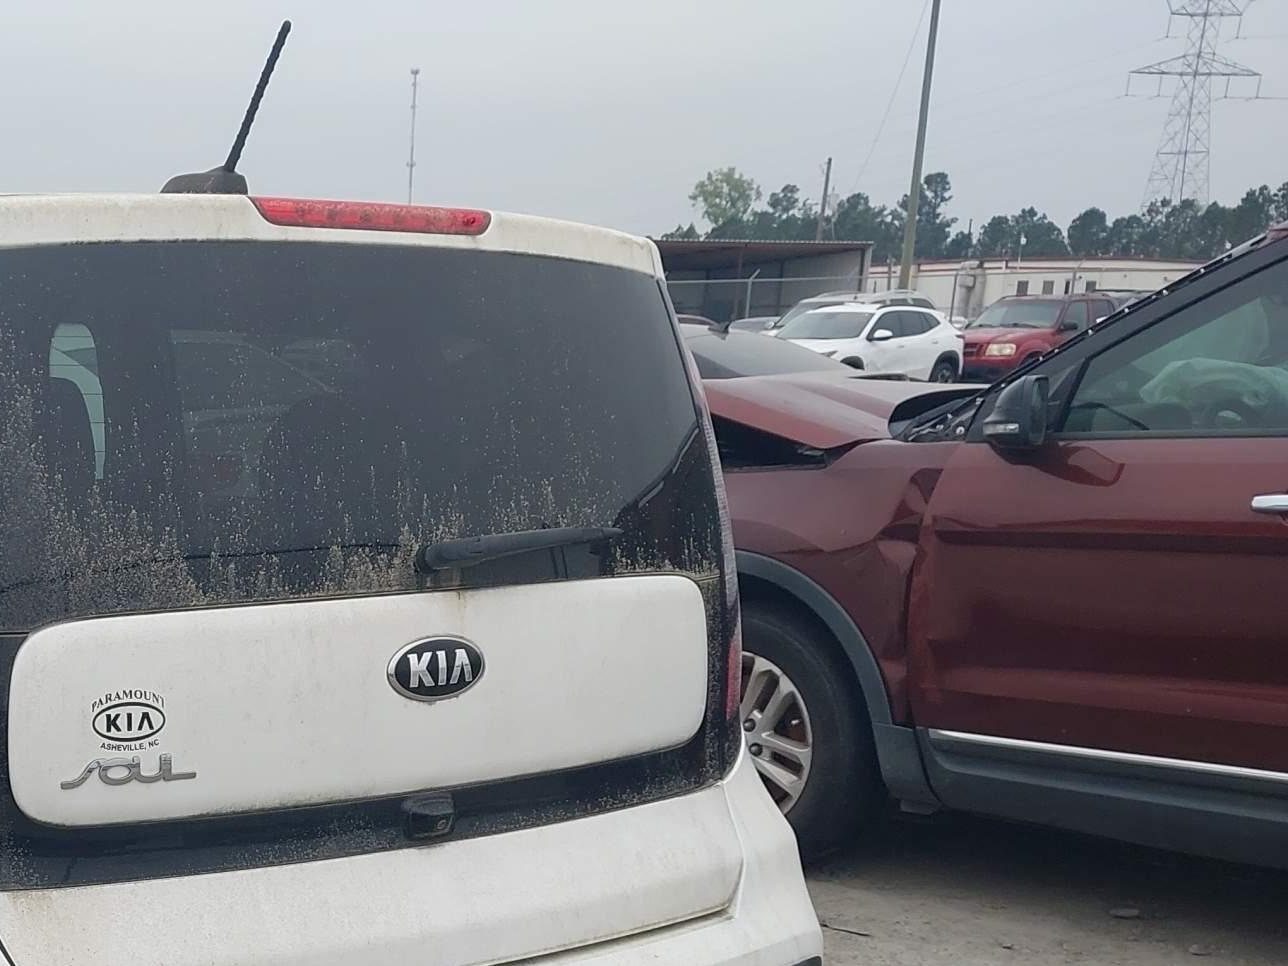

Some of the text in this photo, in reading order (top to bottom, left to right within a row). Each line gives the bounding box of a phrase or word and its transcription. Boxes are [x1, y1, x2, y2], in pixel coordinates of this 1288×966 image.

[407, 648, 473, 688] KIA
[92, 689, 164, 712] PARAMOUNT
[106, 711, 154, 733] KIA
[100, 739, 159, 752] ASHEVILLE, NC
